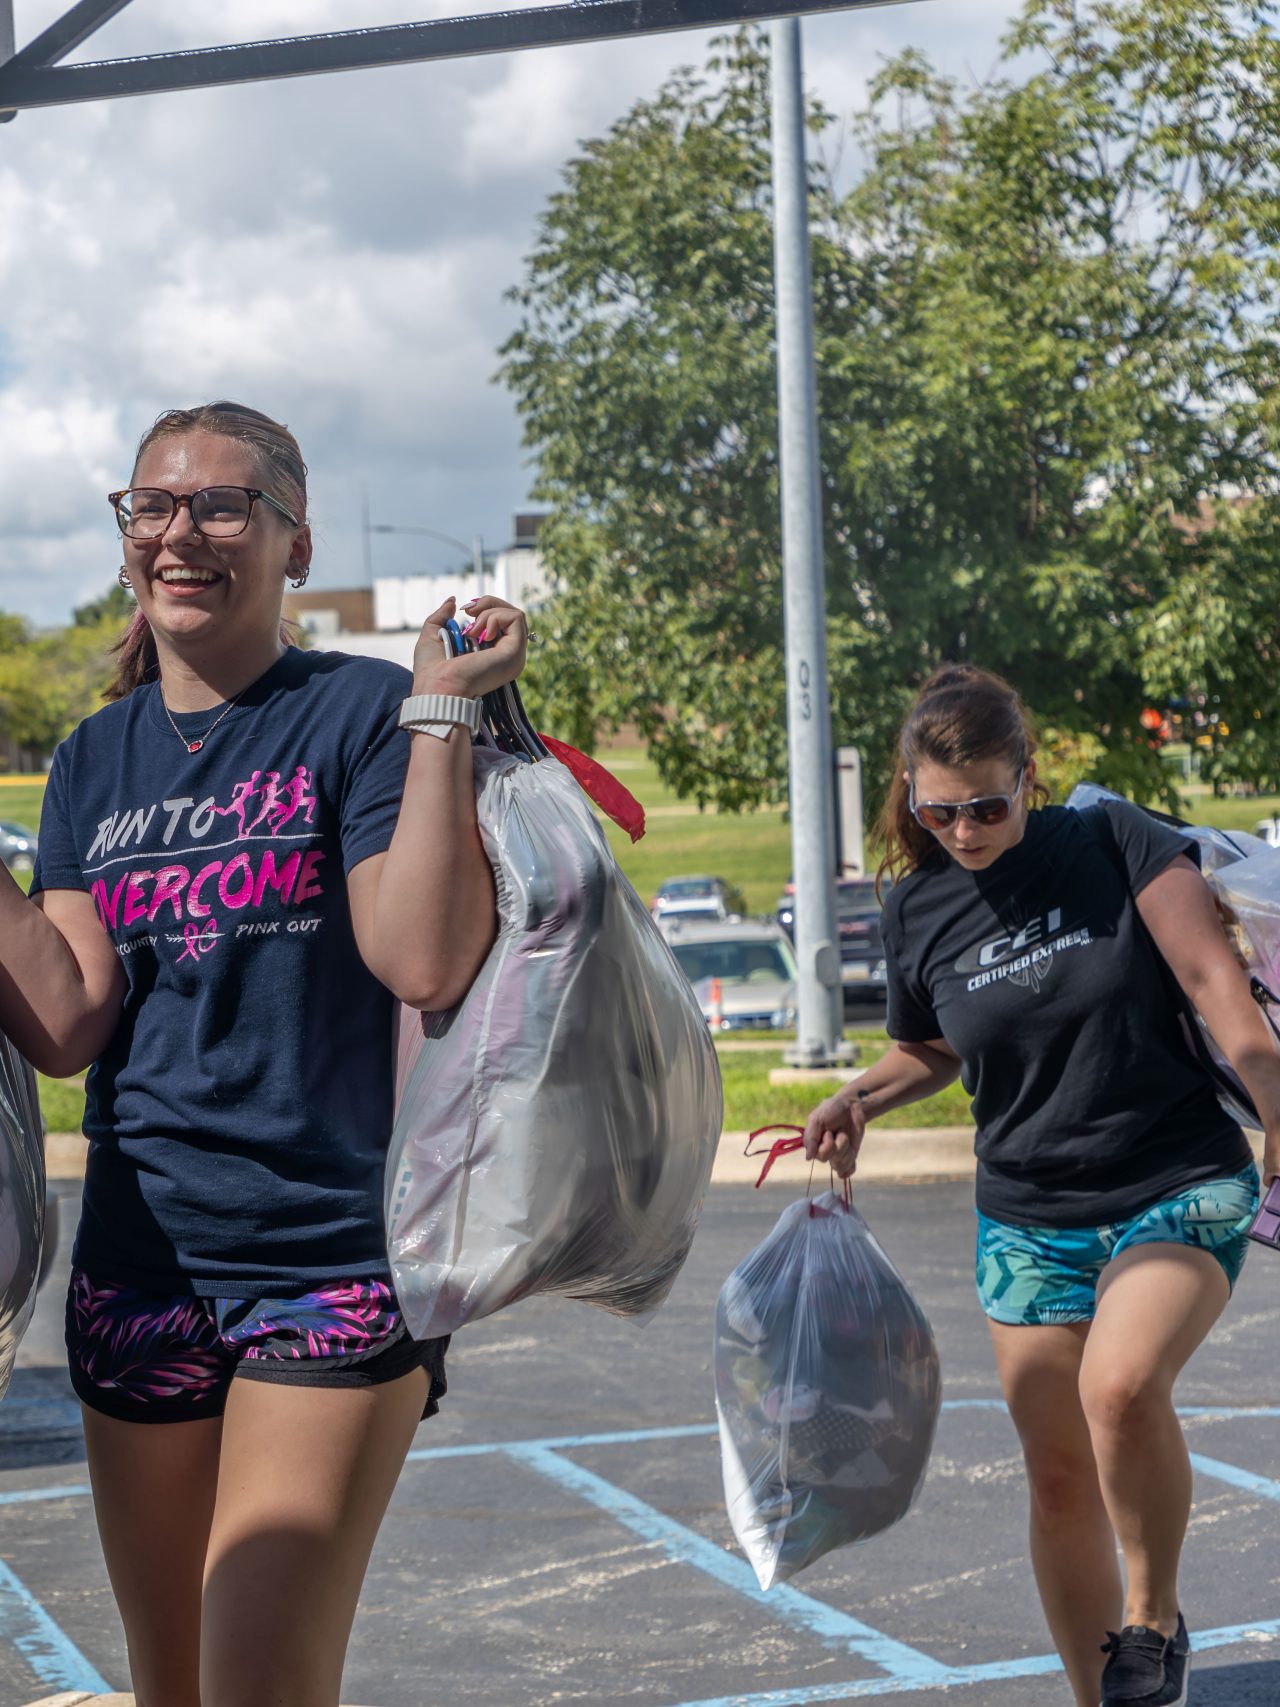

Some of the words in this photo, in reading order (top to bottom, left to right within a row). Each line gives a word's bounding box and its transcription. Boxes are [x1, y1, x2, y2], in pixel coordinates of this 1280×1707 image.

[86, 805, 157, 861] RUN
[162, 796, 216, 845] TO
[235, 921, 280, 938] PINK
[286, 918, 322, 933] OUT
[978, 907, 1061, 967] CEI
[967, 955, 1030, 992] CERTIFIED
